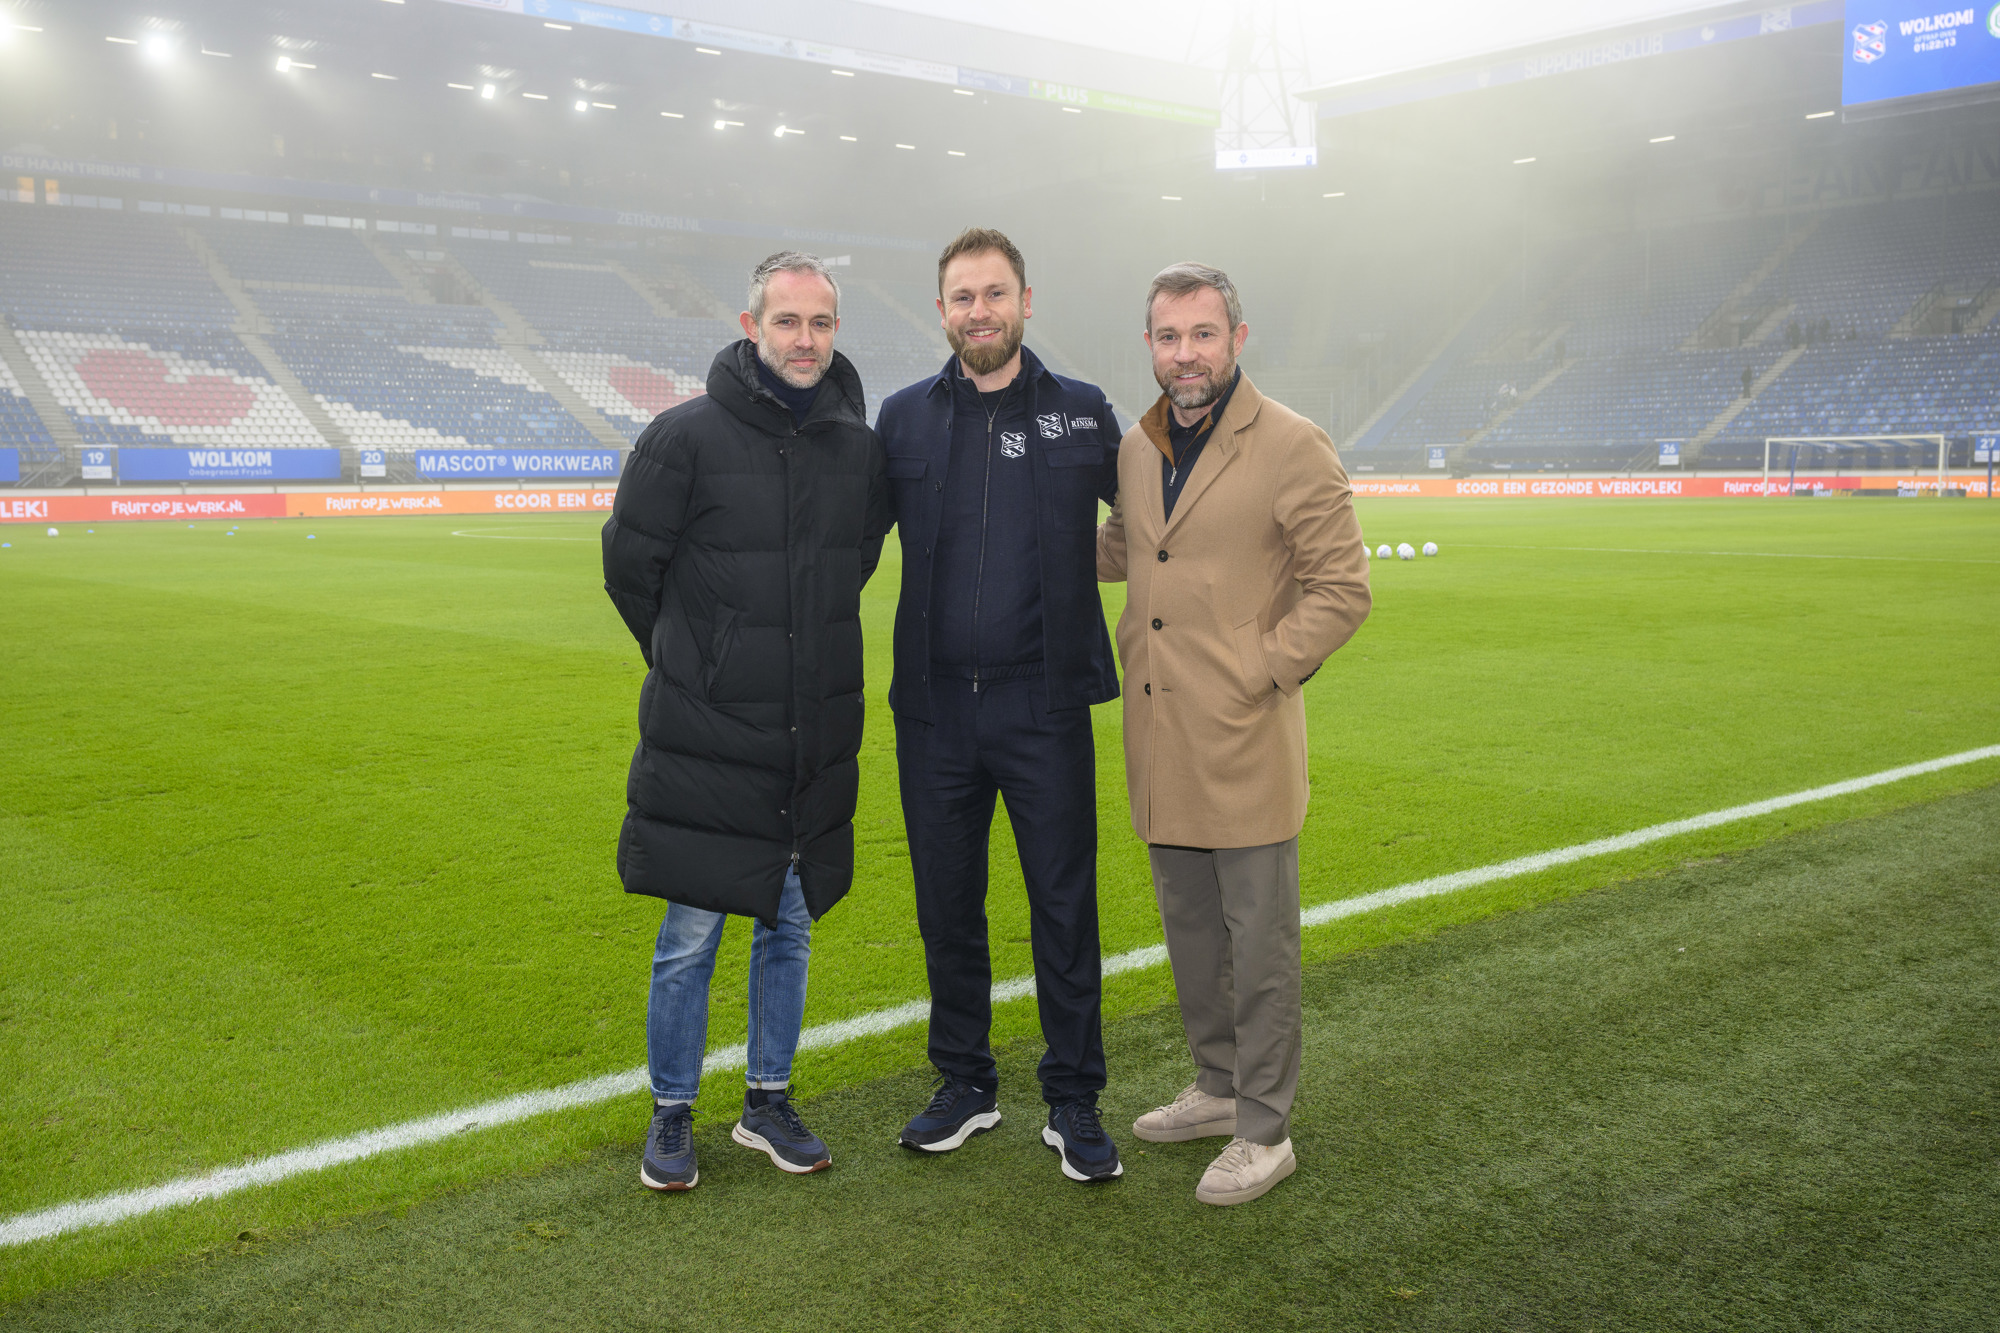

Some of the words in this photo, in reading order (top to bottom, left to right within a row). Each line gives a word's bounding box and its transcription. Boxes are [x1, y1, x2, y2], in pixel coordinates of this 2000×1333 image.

[1899, 8, 1974, 36] WOLKOM!
[1913, 37, 1957, 53] 01:22:13
[1524, 33, 1664, 79] SUPPORTERSCLUB
[1045, 82, 1089, 105] PLUS
[2, 155, 24, 168] DE
[28, 157, 74, 173] HAAN
[77, 162, 141, 179] TRIBUNE
[617, 211, 703, 232] ZETHOVEN.NL
[782, 228, 833, 243] AQUASOFT
[1070, 420, 1098, 428] RINSMA
[1663, 443, 1677, 454] 26
[1980, 438, 1996, 450] 27
[88, 452, 104, 464] 19
[188, 451, 272, 467] WOLKOM
[364, 452, 381, 463] 20
[512, 455, 613, 471] WORKWEAR
[1456, 482, 1498, 494] SCOOR
[1503, 482, 1526, 494] EEN
[1531, 481, 1593, 494] GEZONDE
[1598, 481, 1682, 494] WERKPLEK!
[494, 493, 551, 508] SCOOR
[557, 493, 586, 507] EEN
[592, 493, 616, 506] GE
[0, 501, 48, 518] LEK!
